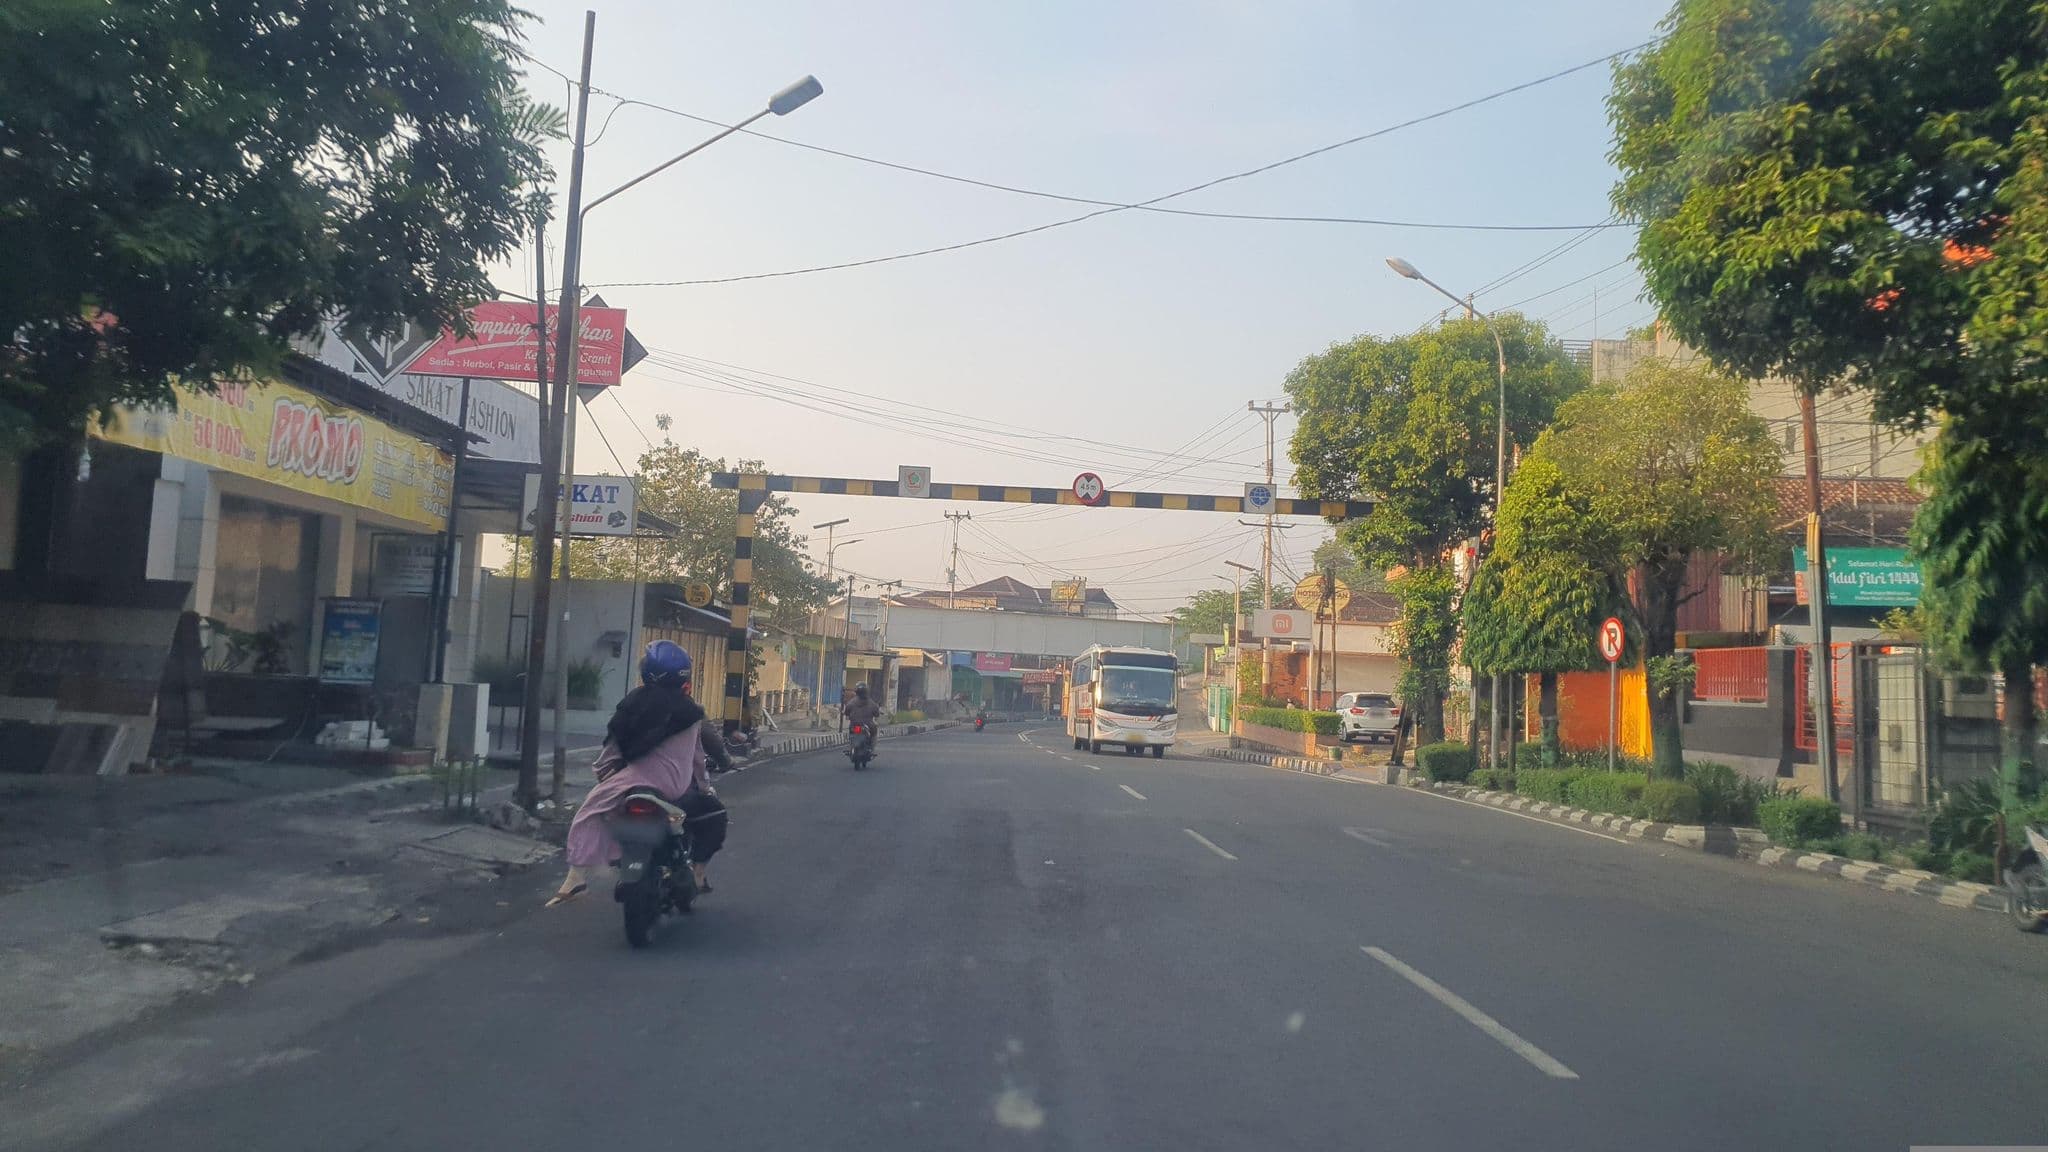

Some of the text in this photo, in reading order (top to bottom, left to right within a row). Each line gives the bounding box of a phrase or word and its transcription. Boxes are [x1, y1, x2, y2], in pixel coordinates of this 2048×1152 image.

[471, 316, 534, 343] amping
[429, 357, 455, 367] Sedia
[498, 362, 522, 371] Pasir
[524, 363, 531, 371] &
[406, 375, 517, 440] SAKAT ASHION
[267, 397, 364, 485] PROMO
[557, 484, 620, 504] KAT
